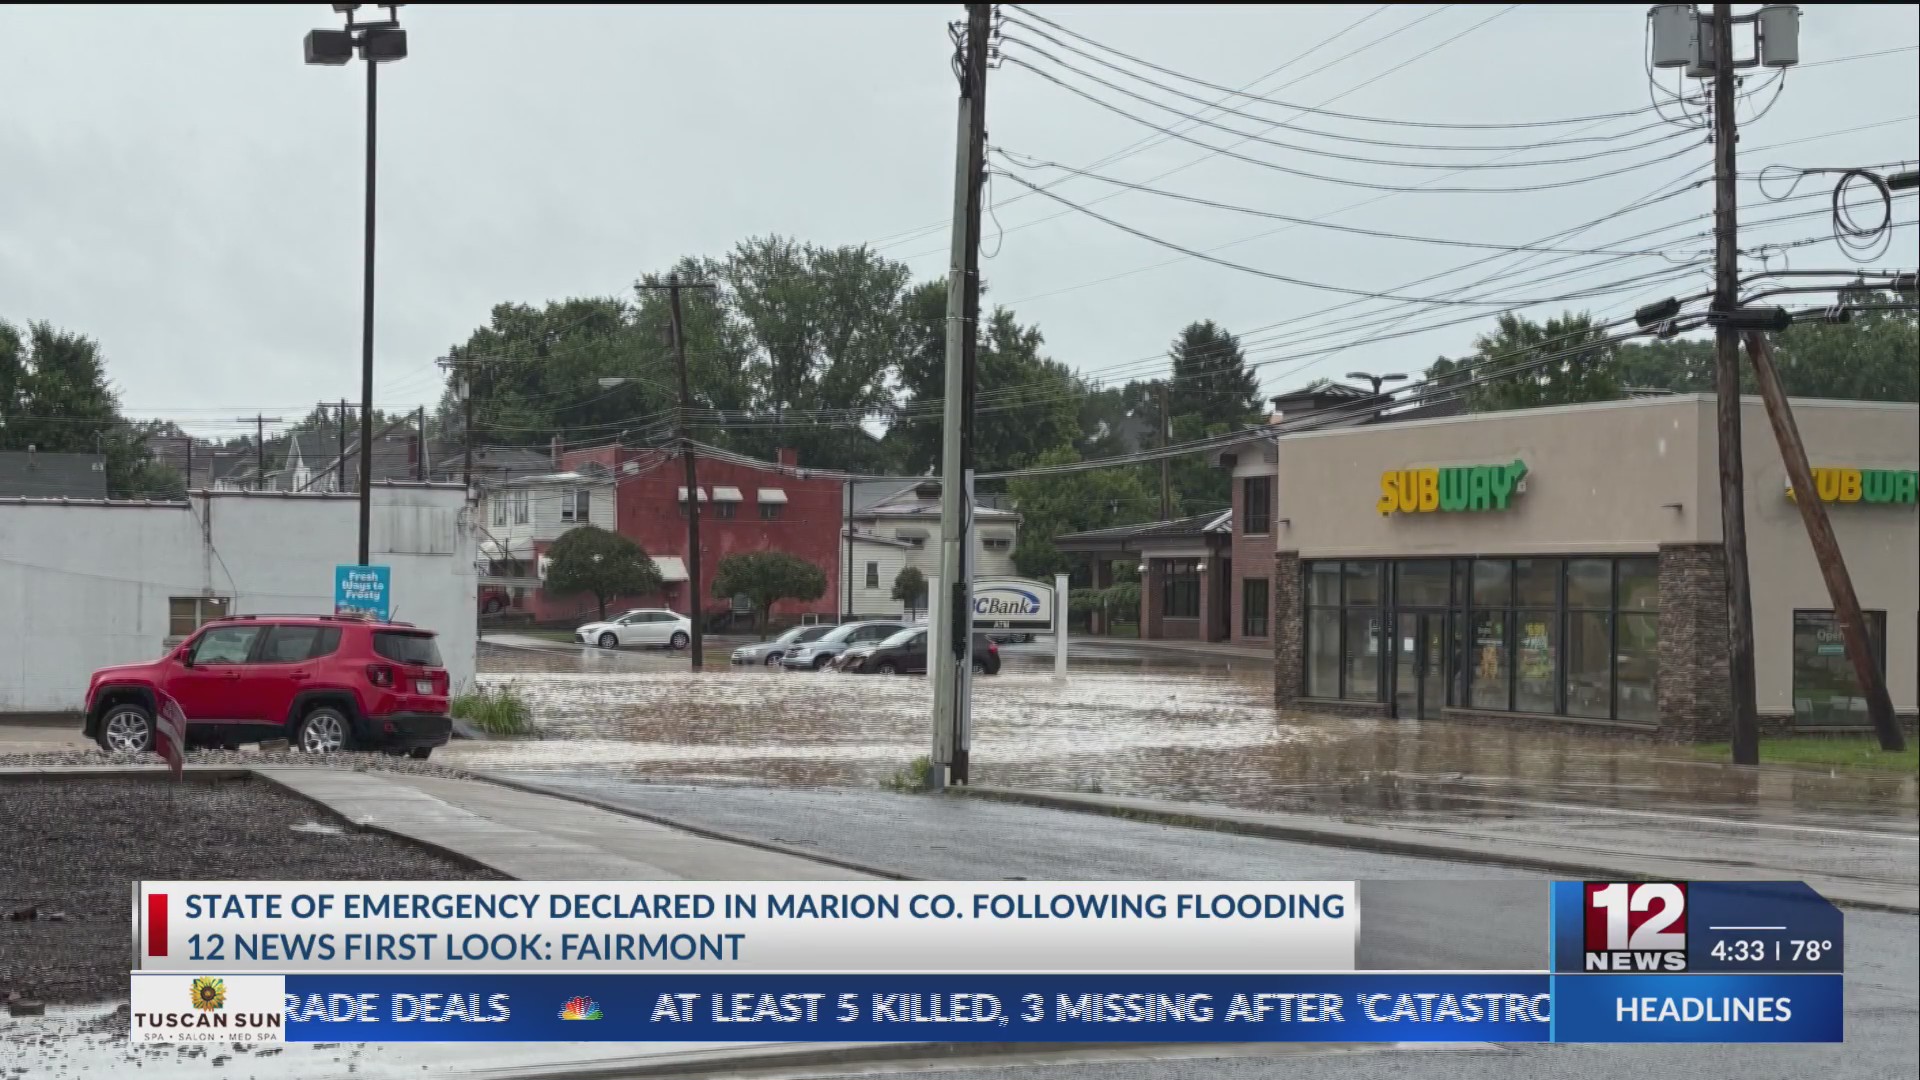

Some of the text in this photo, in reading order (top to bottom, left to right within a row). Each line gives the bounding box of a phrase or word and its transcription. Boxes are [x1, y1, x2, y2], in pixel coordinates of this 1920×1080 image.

[1376, 459, 1528, 517] SUBWAY
[1785, 468, 1918, 503] UBWA
[349, 571, 378, 581] Fresh
[342, 580, 384, 591] Ways to
[346, 590, 380, 601] Frosty
[972, 597, 1031, 614] CBank
[994, 620, 1010, 629] ATM
